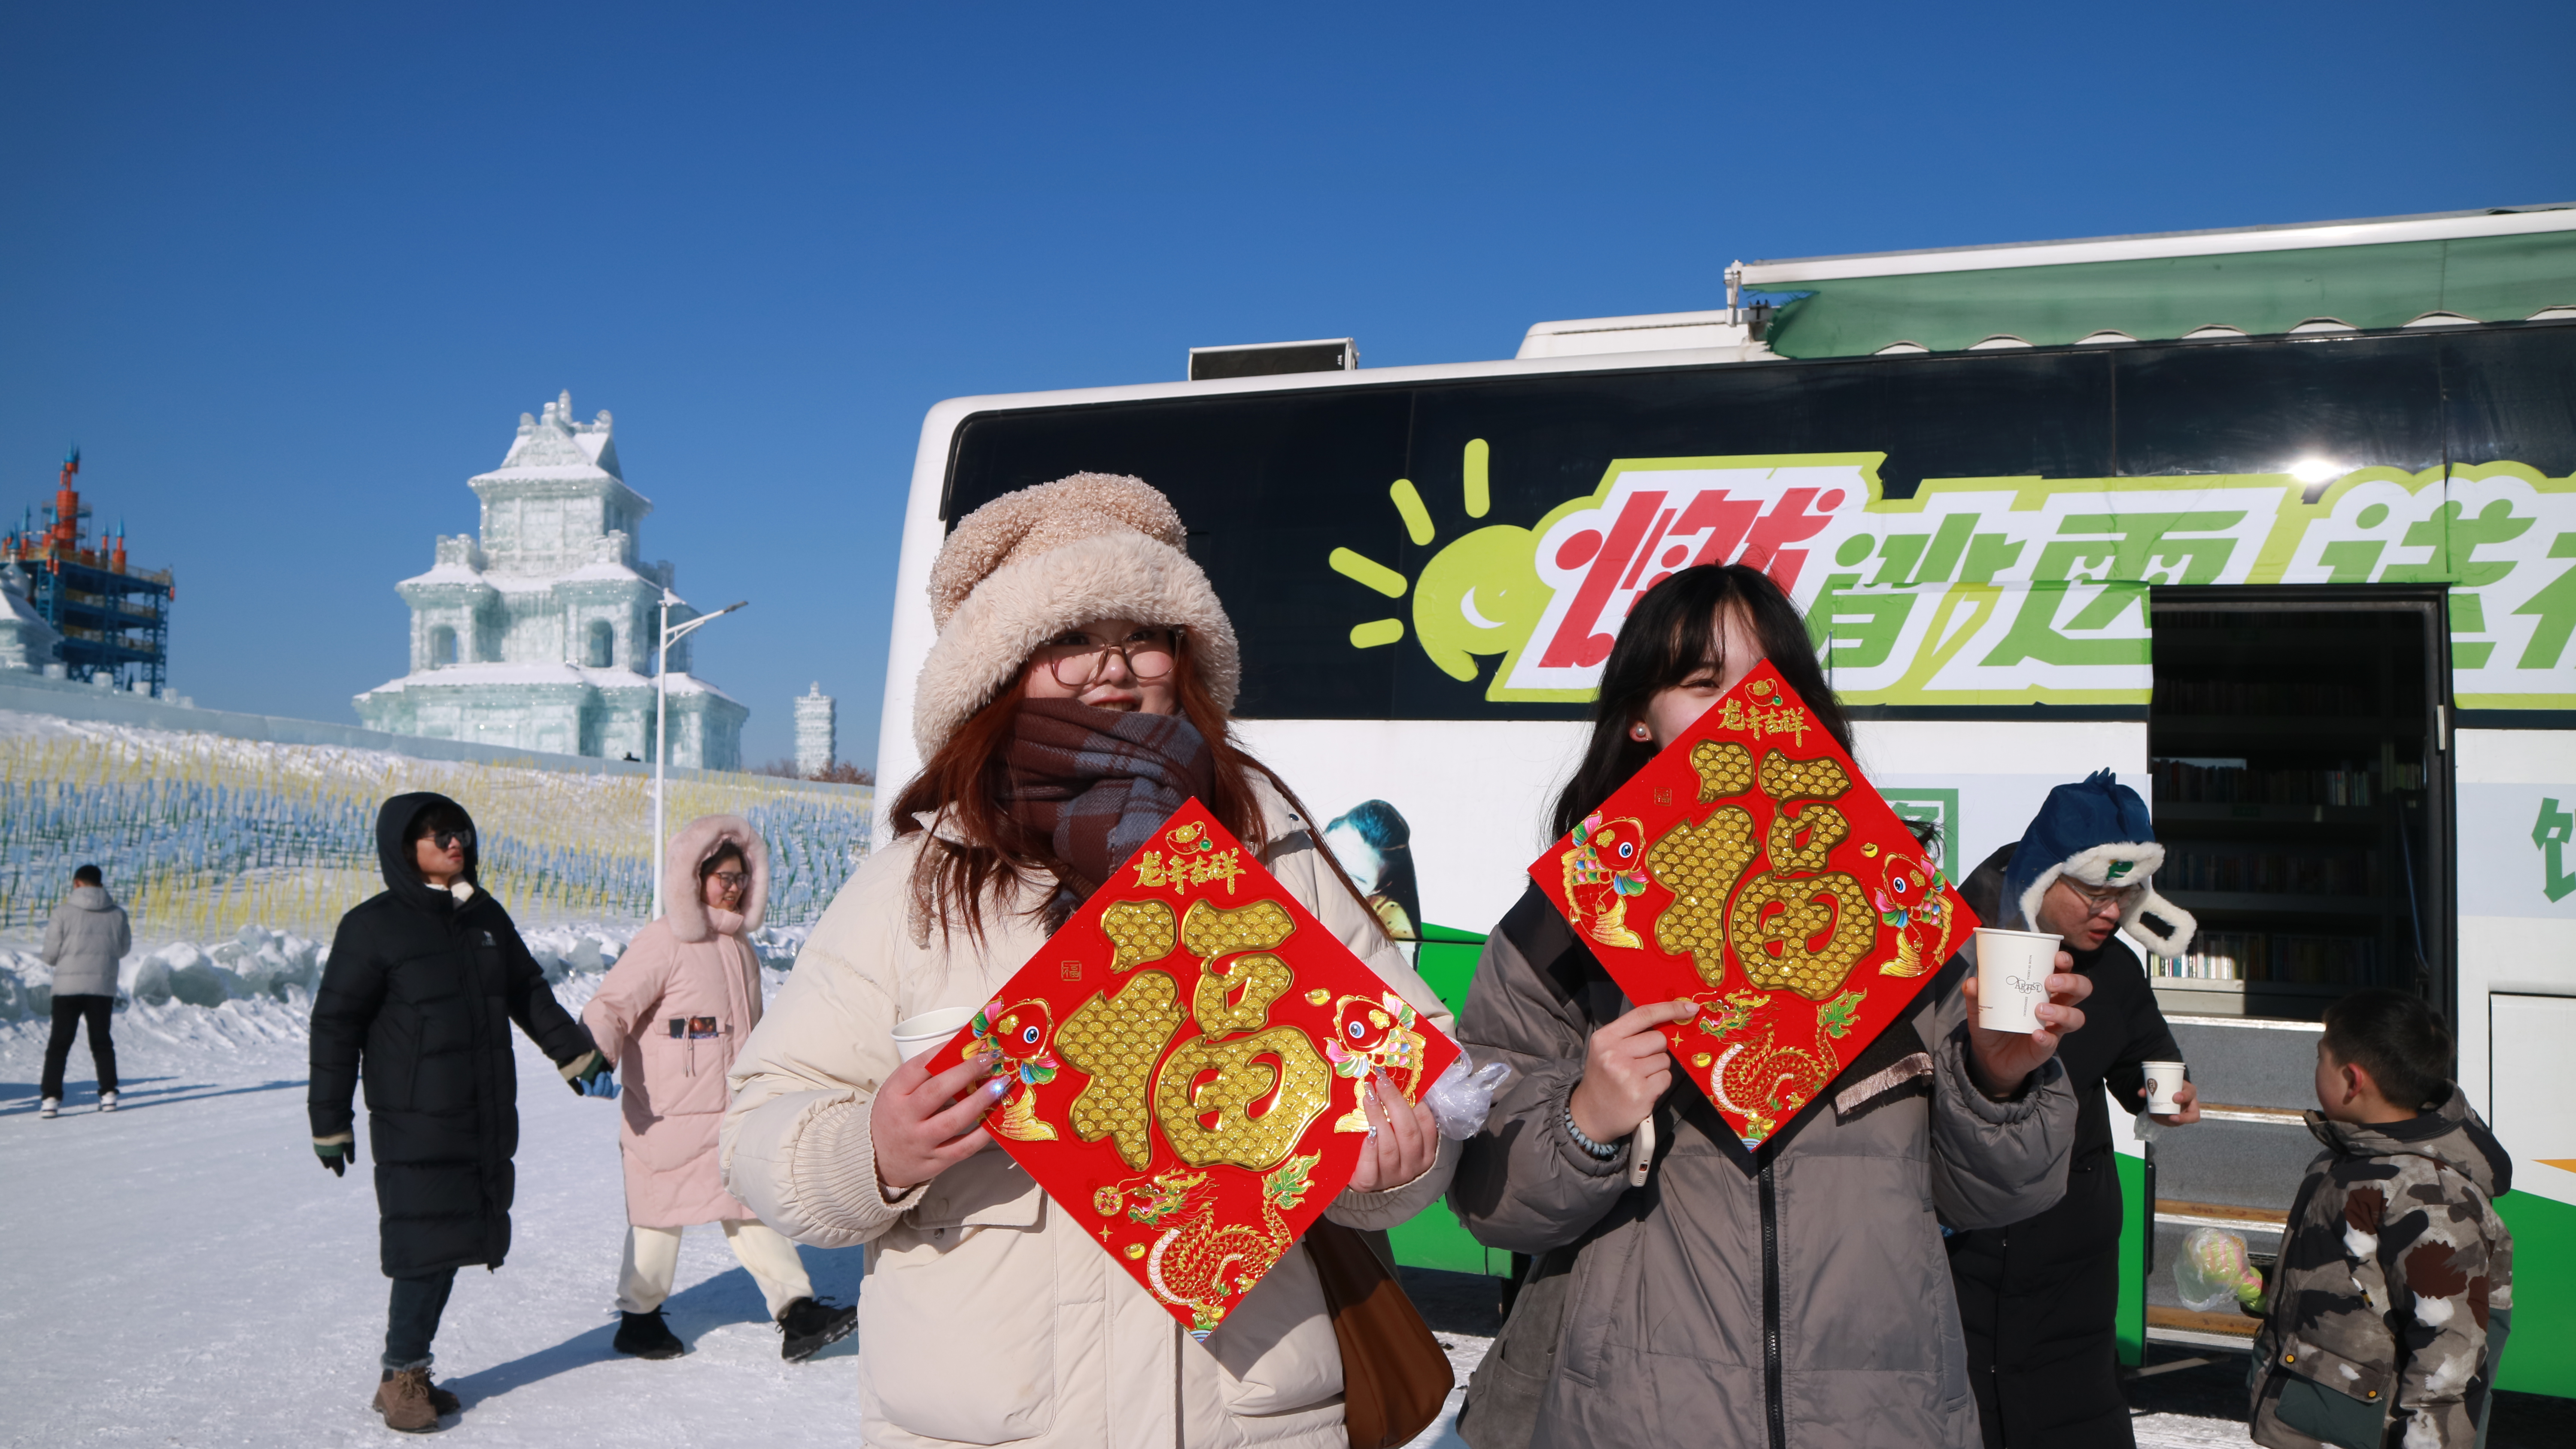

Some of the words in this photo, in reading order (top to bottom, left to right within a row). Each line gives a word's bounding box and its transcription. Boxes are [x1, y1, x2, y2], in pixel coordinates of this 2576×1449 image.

[1717, 697, 1811, 748] 龙年吉祥
[1132, 848, 1246, 895] 龙年吉祥
[1646, 740, 1877, 1001] 福
[1054, 899, 1332, 1171] 福
